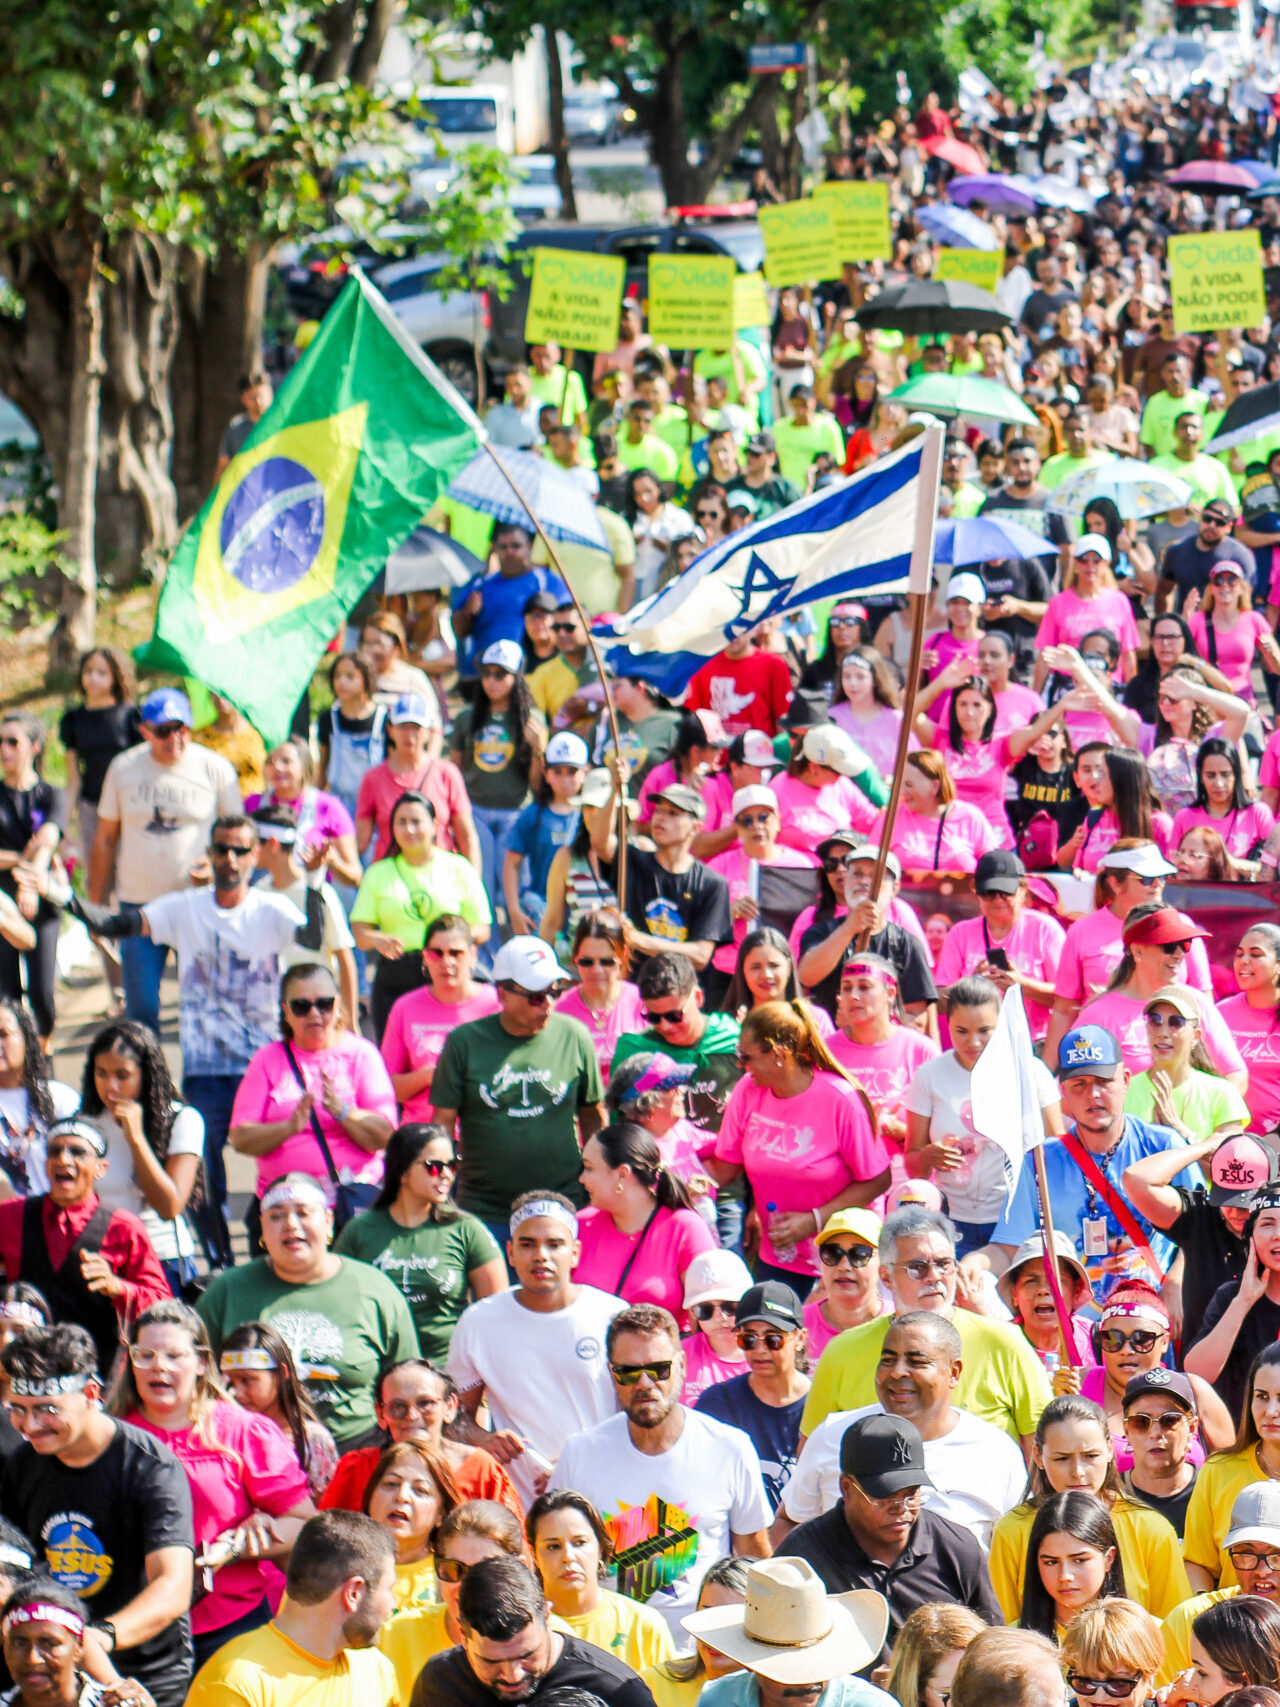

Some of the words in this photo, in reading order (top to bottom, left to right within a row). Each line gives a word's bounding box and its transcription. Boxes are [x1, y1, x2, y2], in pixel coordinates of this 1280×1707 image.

[1191, 275, 1201, 287] A
[1205, 272, 1243, 286] VIDA
[551, 290, 560, 302] A
[564, 292, 600, 308] VIDA
[1177, 291, 1212, 307] NÃO
[1217, 290, 1259, 305] PODE
[534, 306, 567, 323] NÃO
[571, 312, 613, 326] PODE
[1191, 310, 1248, 326] PARAR!
[1231, 1029, 1268, 1039] OVIMENTO
[1066, 1047, 1104, 1065] JESUS
[1220, 1168, 1255, 1185] JESUS
[224, 1352, 269, 1364] SUS
